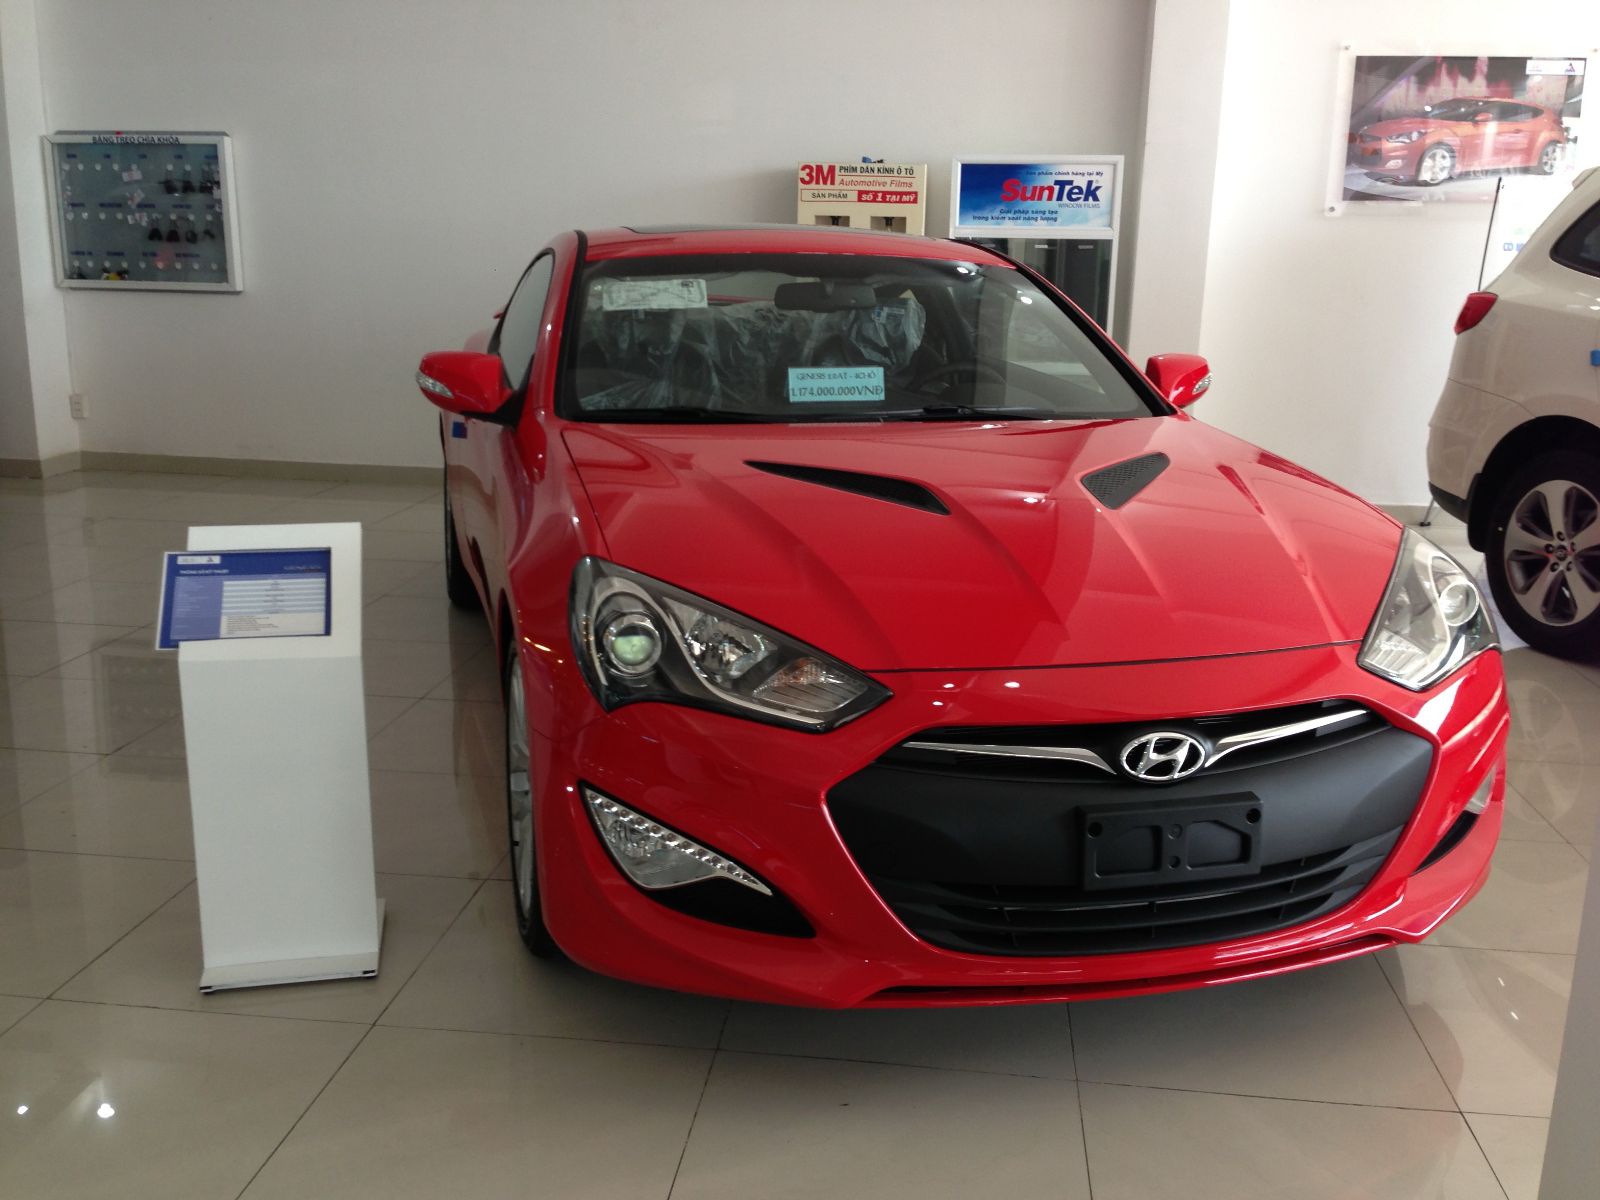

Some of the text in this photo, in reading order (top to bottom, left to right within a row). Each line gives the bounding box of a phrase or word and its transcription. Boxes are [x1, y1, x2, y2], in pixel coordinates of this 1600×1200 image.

[799, 164, 836, 186] 3M
[896, 165, 902, 175] Ô
[838, 179, 912, 188] Automotive Films
[1001, 178, 1102, 202] SunTek
[875, 192, 882, 202] 1
